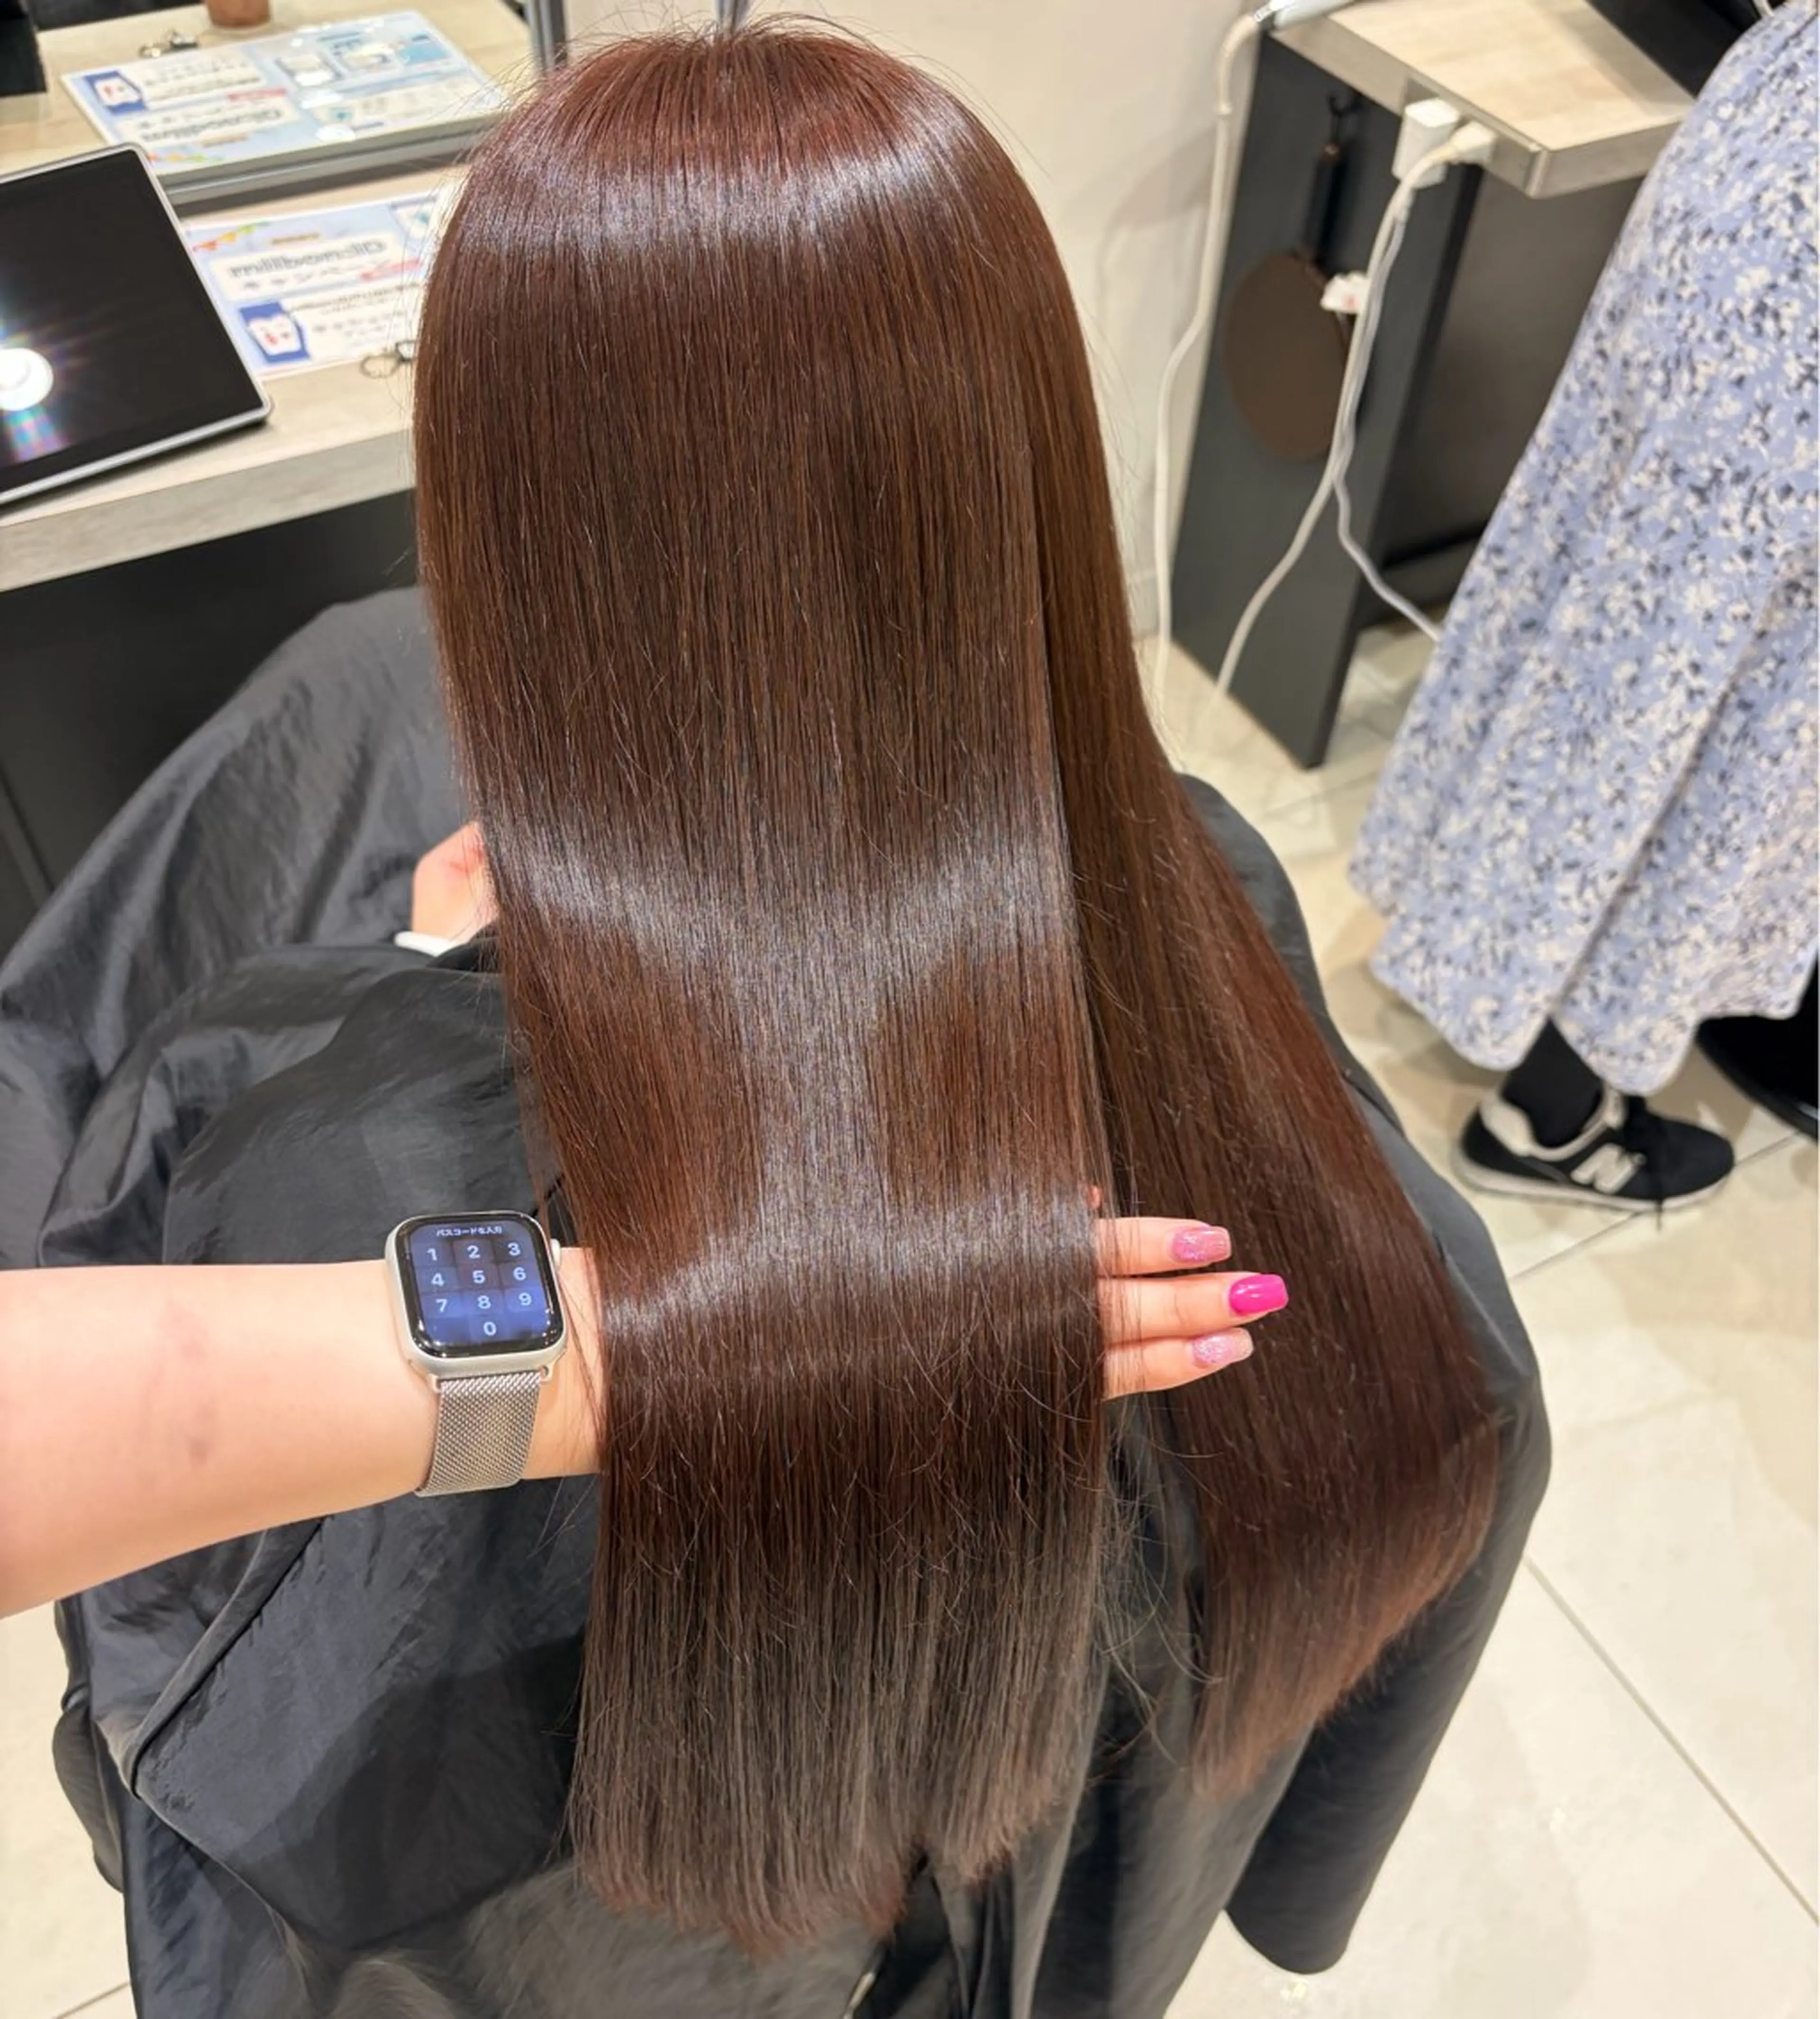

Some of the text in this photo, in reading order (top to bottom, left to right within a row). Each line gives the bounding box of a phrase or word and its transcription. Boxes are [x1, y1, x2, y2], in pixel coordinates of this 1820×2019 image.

[1570, 1143, 1646, 1193] N
[436, 1226, 502, 1237] パスコードを入力
[427, 1242, 521, 1261] 1 2 3
[431, 1267, 527, 1287] 4 5 6
[436, 1292, 532, 1312] 7 8 9
[483, 1321, 497, 1336] 0
